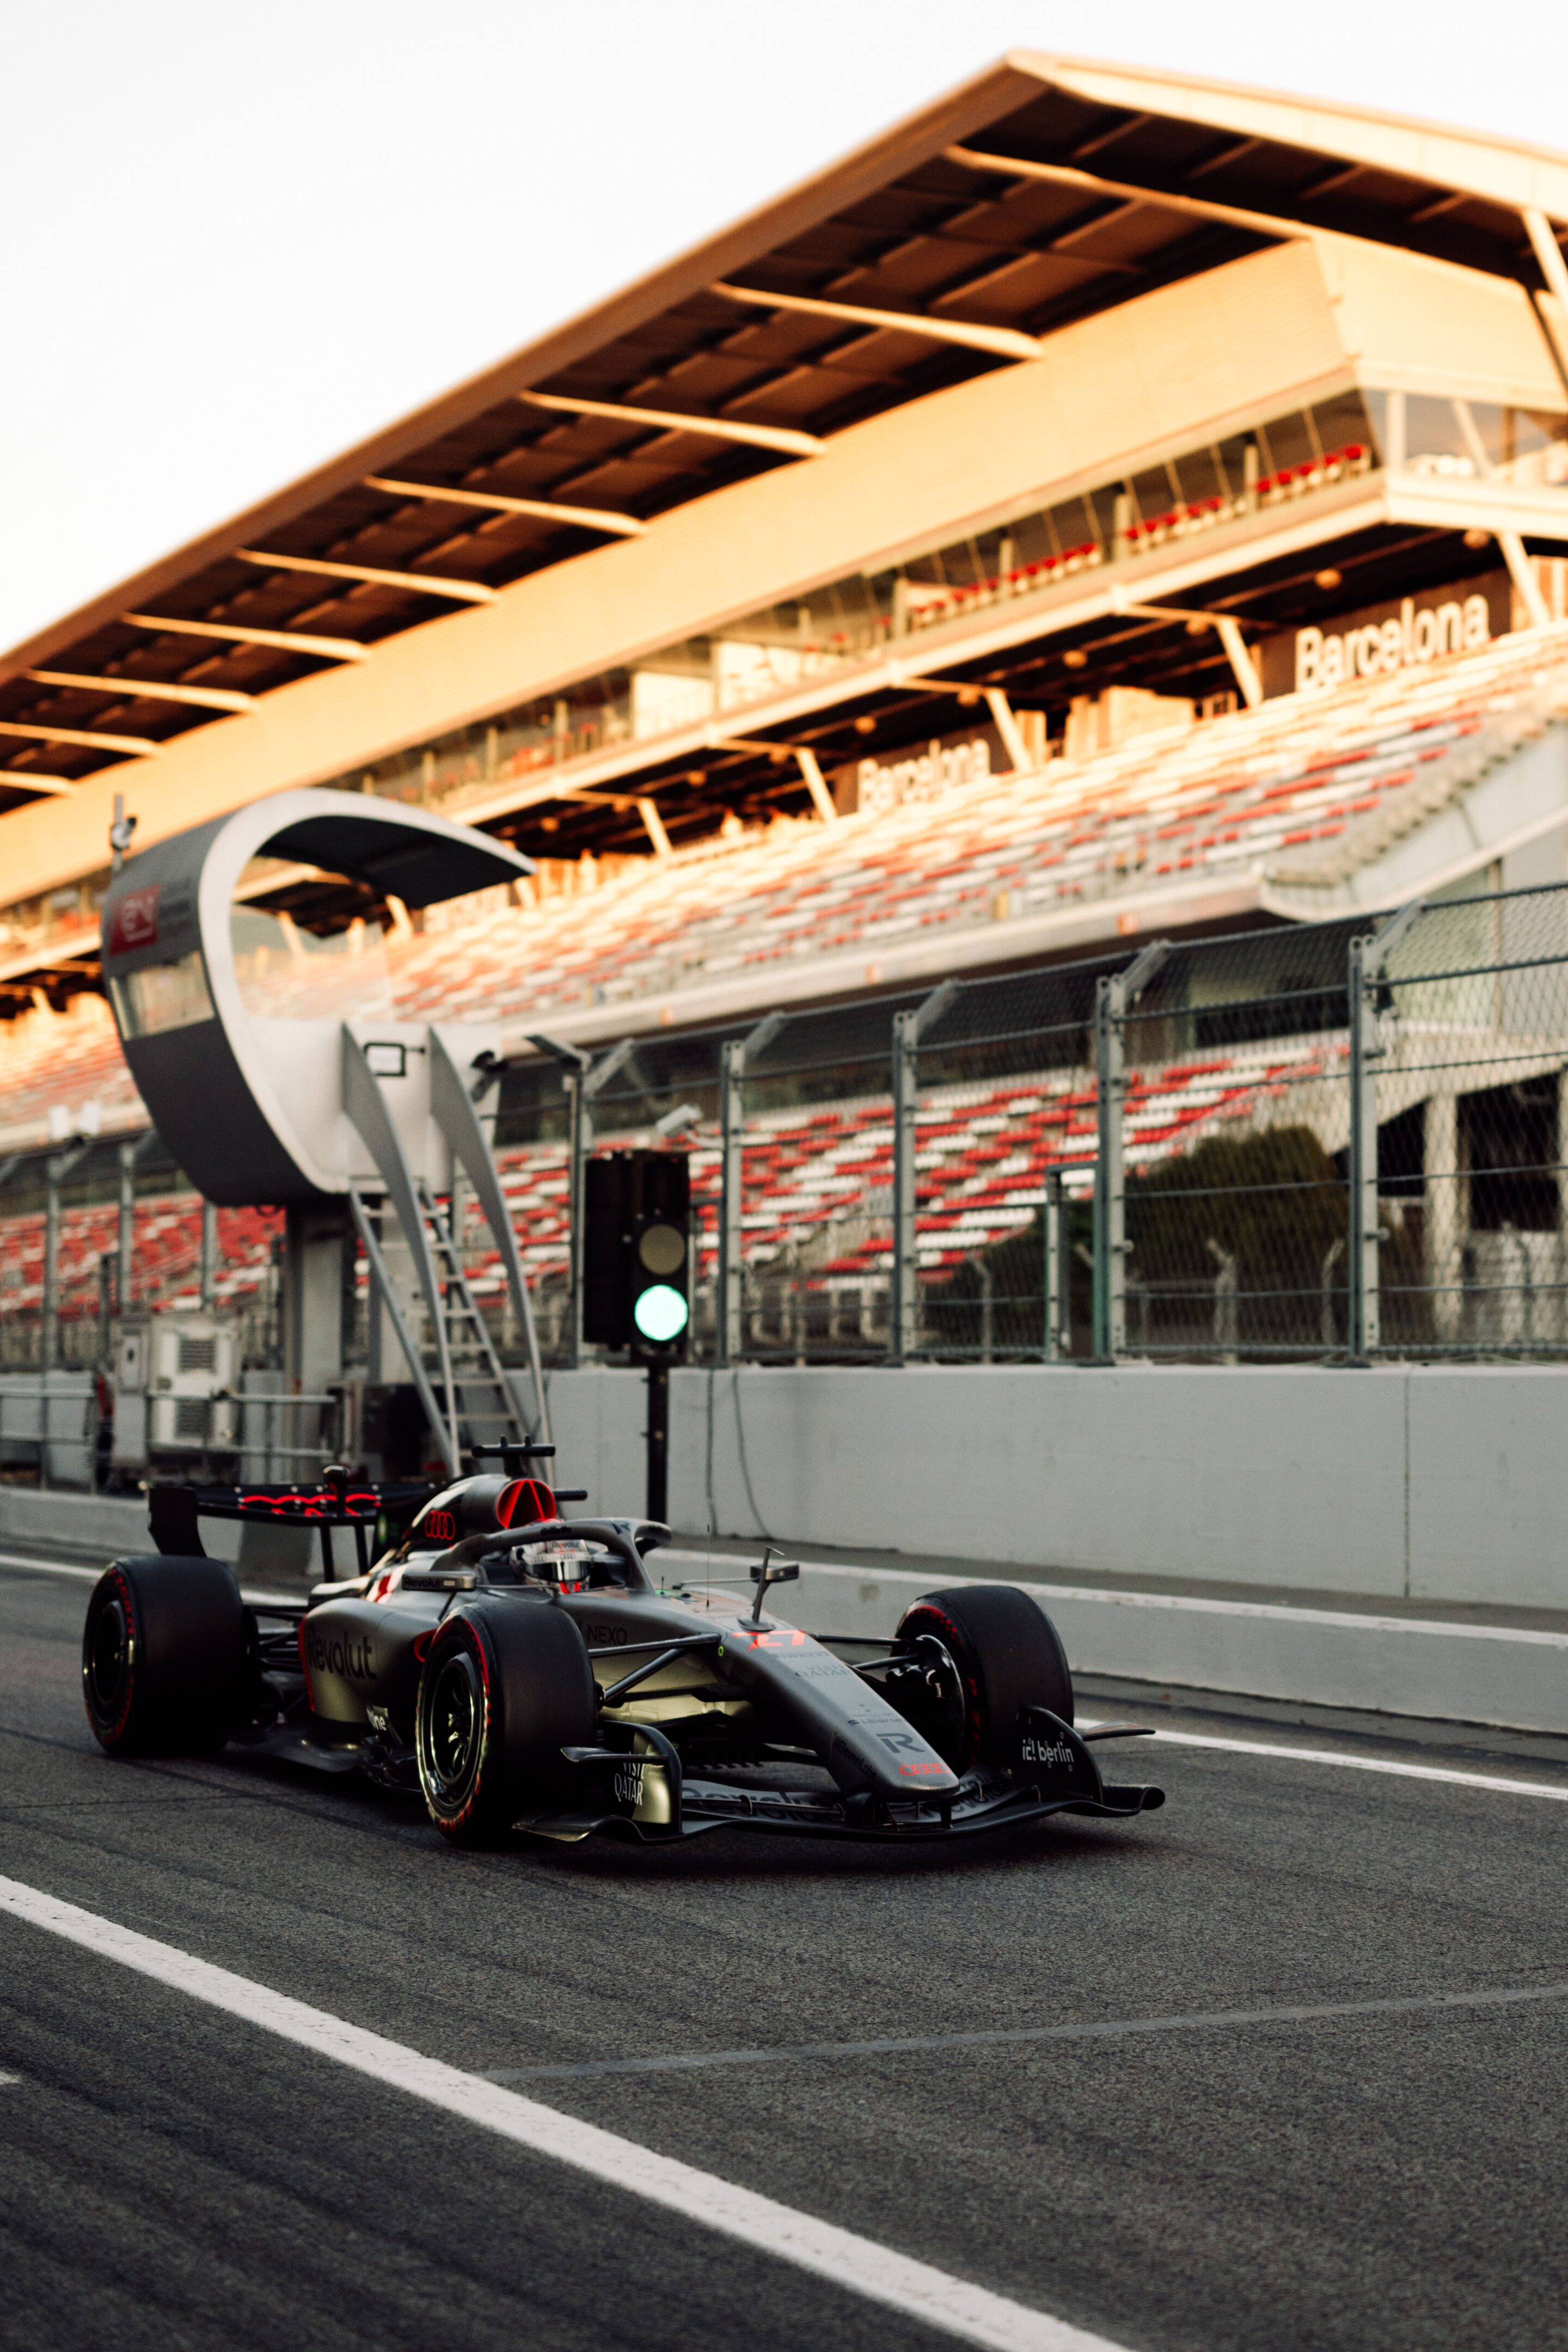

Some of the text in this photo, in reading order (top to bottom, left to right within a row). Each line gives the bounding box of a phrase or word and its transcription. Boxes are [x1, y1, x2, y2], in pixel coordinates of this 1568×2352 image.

[1295, 594, 1490, 691] Barcelona
[858, 739, 990, 813] Barcelona
[404, 1577, 440, 1587] Revolut
[587, 1625, 627, 1645] NEXO
[732, 1630, 805, 1651] 27
[308, 1625, 376, 1679] Revolut
[875, 1733, 926, 1753] R
[1022, 1738, 1074, 1762] ic! berlin
[614, 1773, 643, 1805] QATAR
